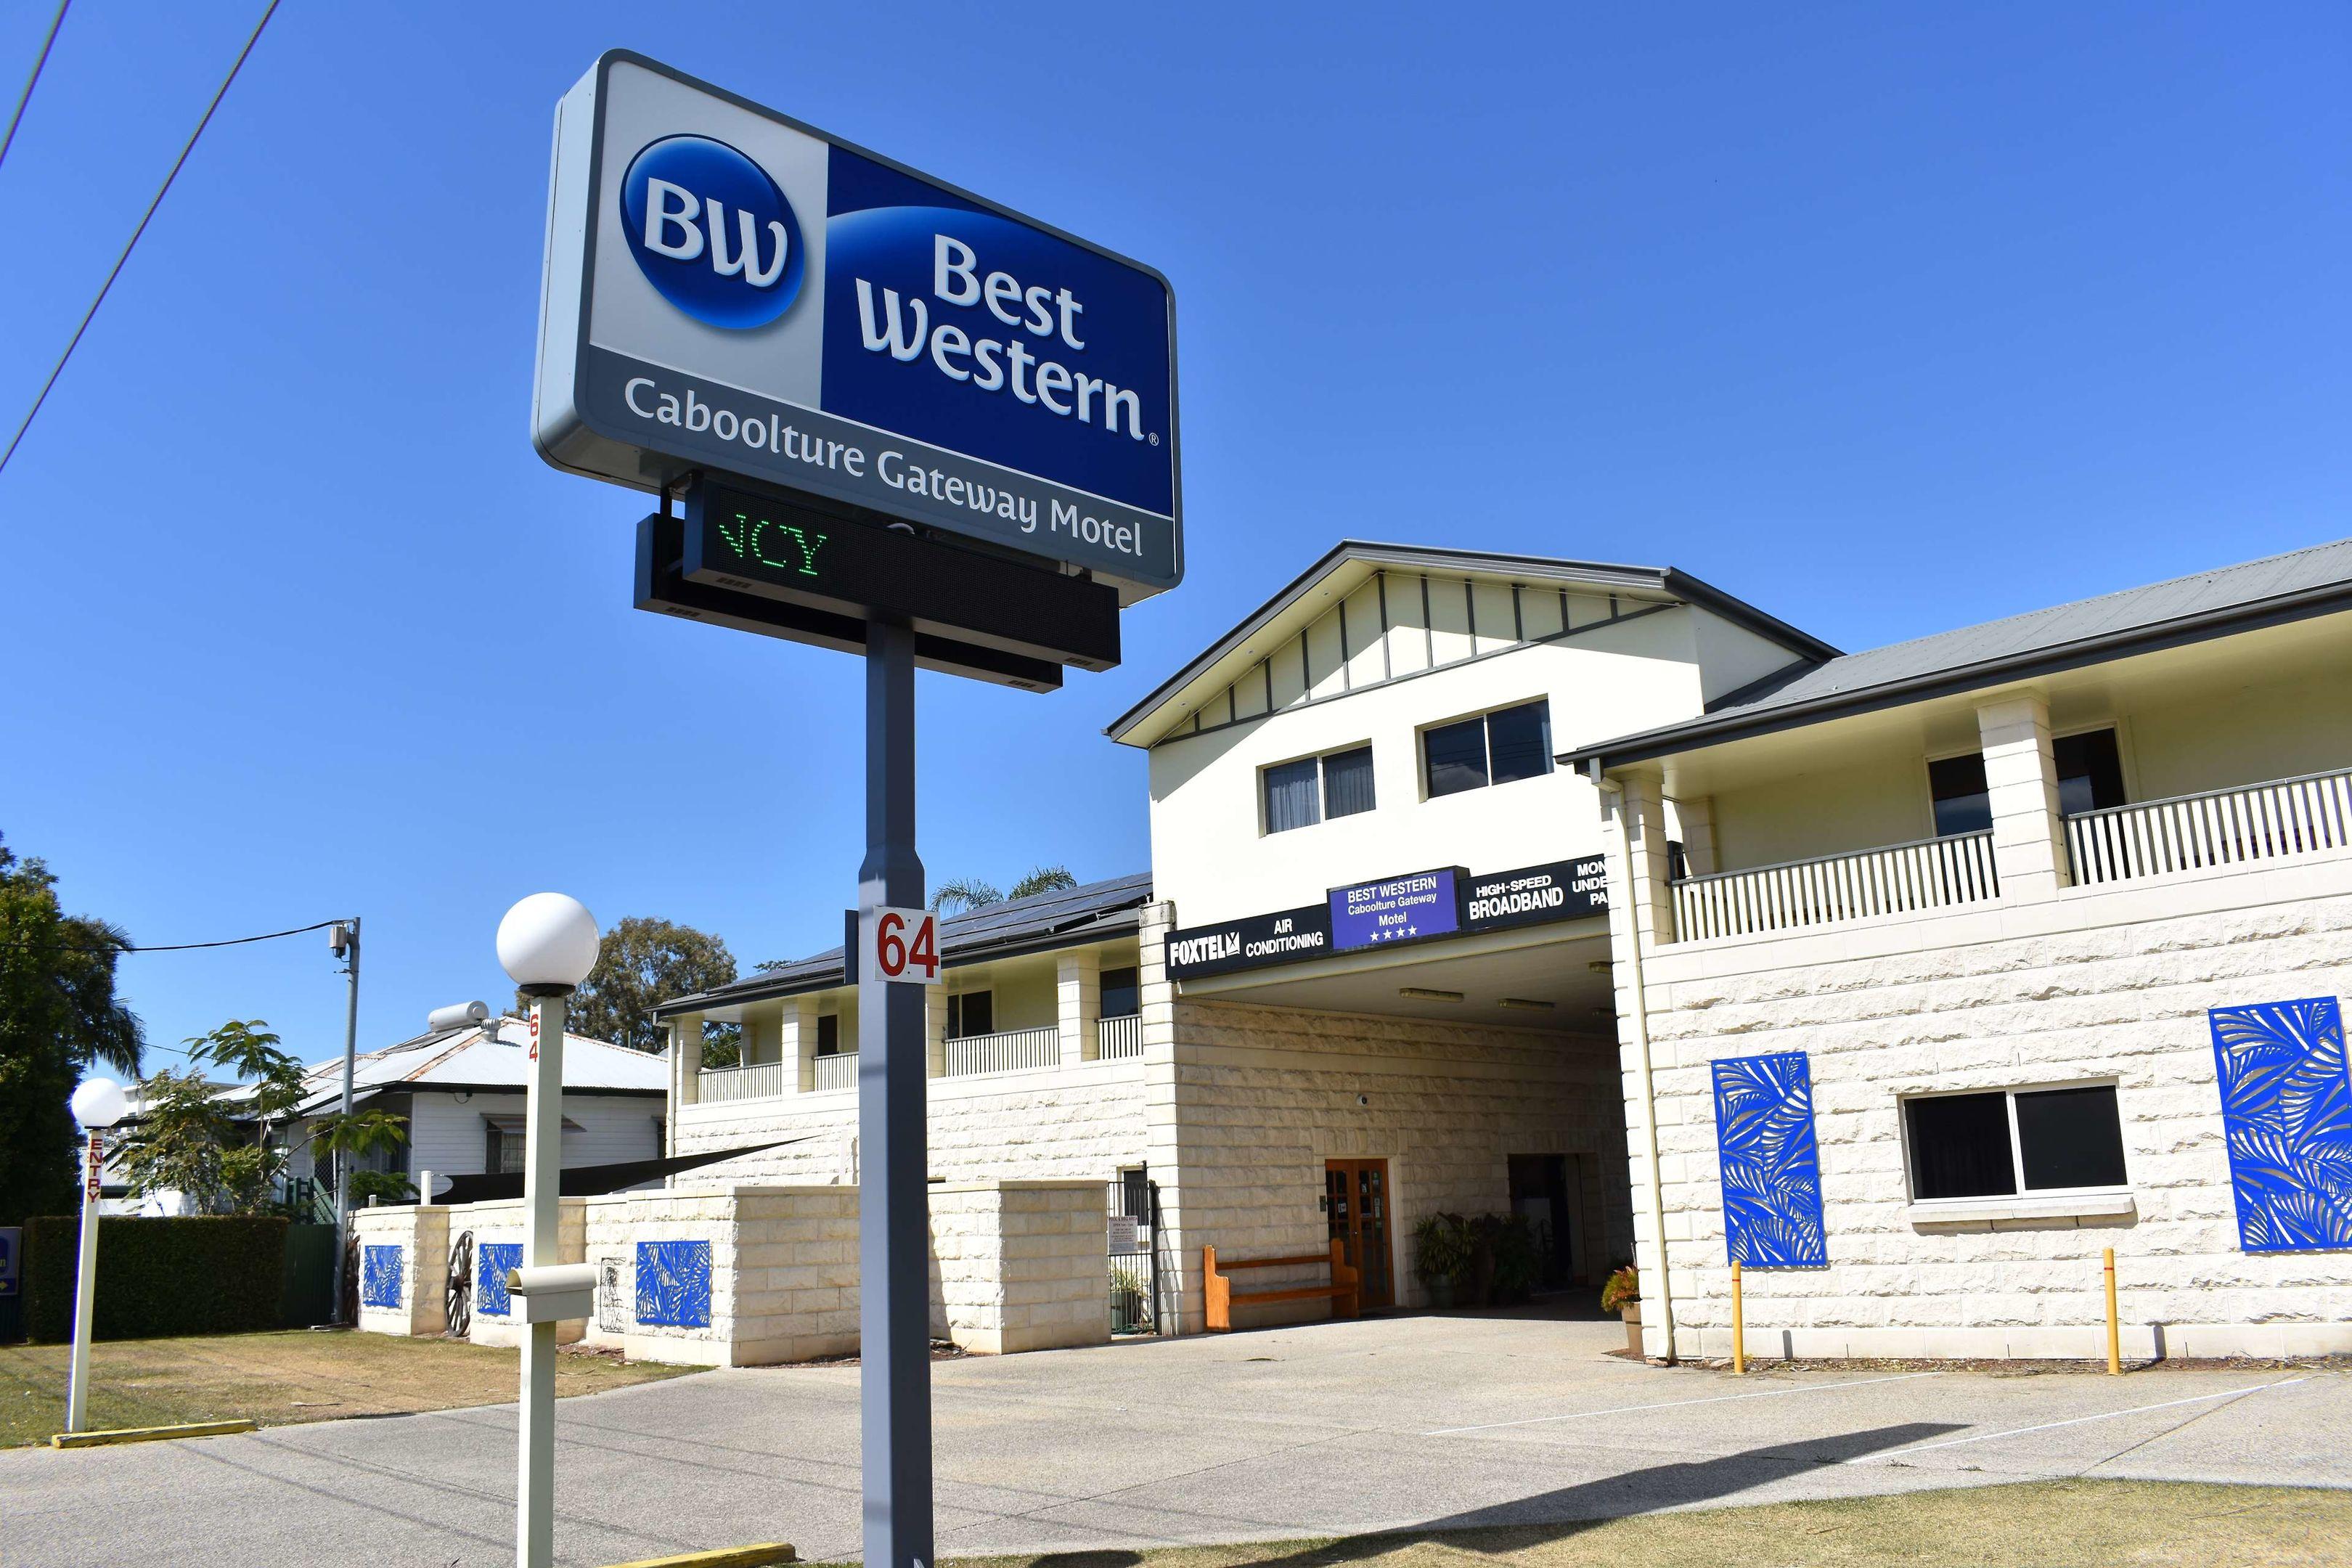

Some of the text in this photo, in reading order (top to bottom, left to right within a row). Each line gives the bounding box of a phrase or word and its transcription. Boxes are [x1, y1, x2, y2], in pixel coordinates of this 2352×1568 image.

[645, 176, 788, 287] BW
[934, 233, 1085, 351] Best
[624, 377, 1143, 557] Caboolture Gateway Motel
[1347, 875, 1437, 904] BEST WESTERN
[1469, 886, 1564, 920] BROADBAND
[1476, 875, 1552, 898] HIGH-SPEED
[1347, 893, 1437, 915] Caboolture Gateway
[1379, 911, 1407, 927] Motel
[1274, 918, 1293, 935] AIR
[877, 912, 939, 979] 64
[1169, 934, 1226, 967] FOXTEL
[1246, 931, 1324, 957] CONDITIONING
[529, 1013, 539, 1063] 64
[87, 1138, 103, 1204] ENTRY
